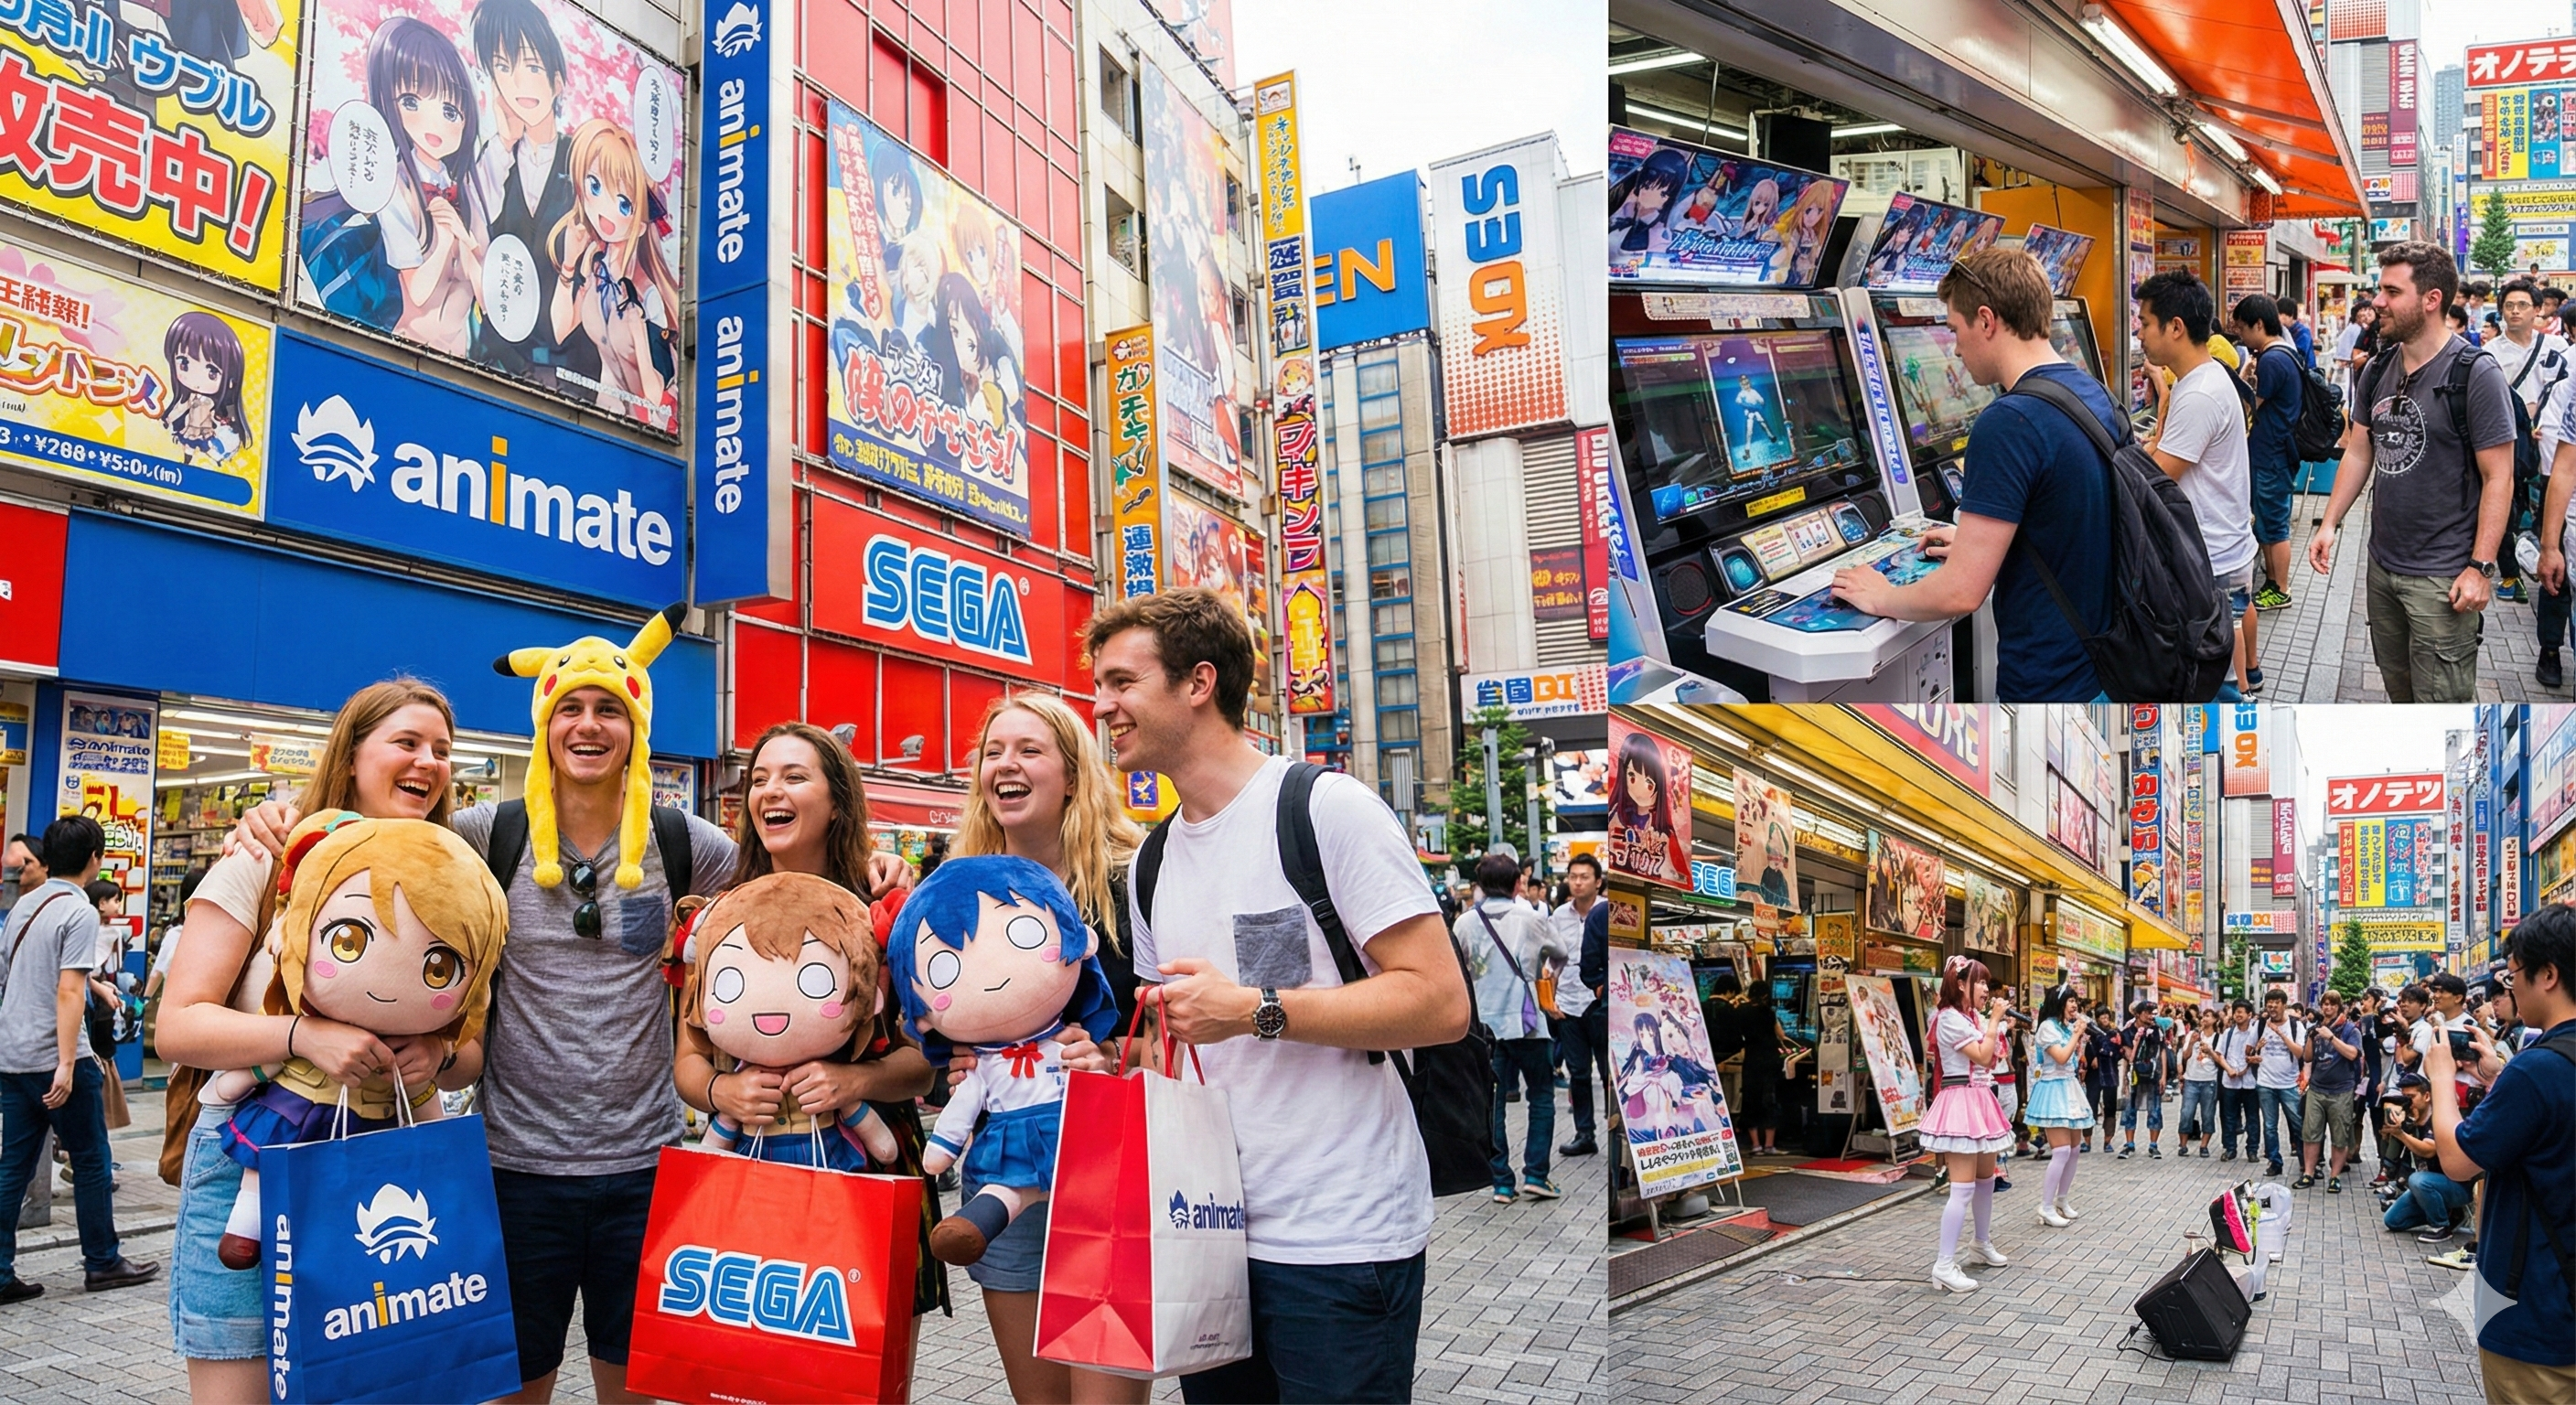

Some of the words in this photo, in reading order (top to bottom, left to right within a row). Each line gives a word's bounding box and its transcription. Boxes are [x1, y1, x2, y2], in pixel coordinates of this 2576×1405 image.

[719, 79, 760, 263] animate
[714, 316, 759, 515] animate
[390, 434, 673, 567] animate
[863, 534, 1033, 665] SEGA
[1691, 860, 1736, 900] SEG
[272, 1213, 293, 1400] animate
[323, 1271, 488, 1342] animate
[658, 1243, 856, 1348] SEGA
